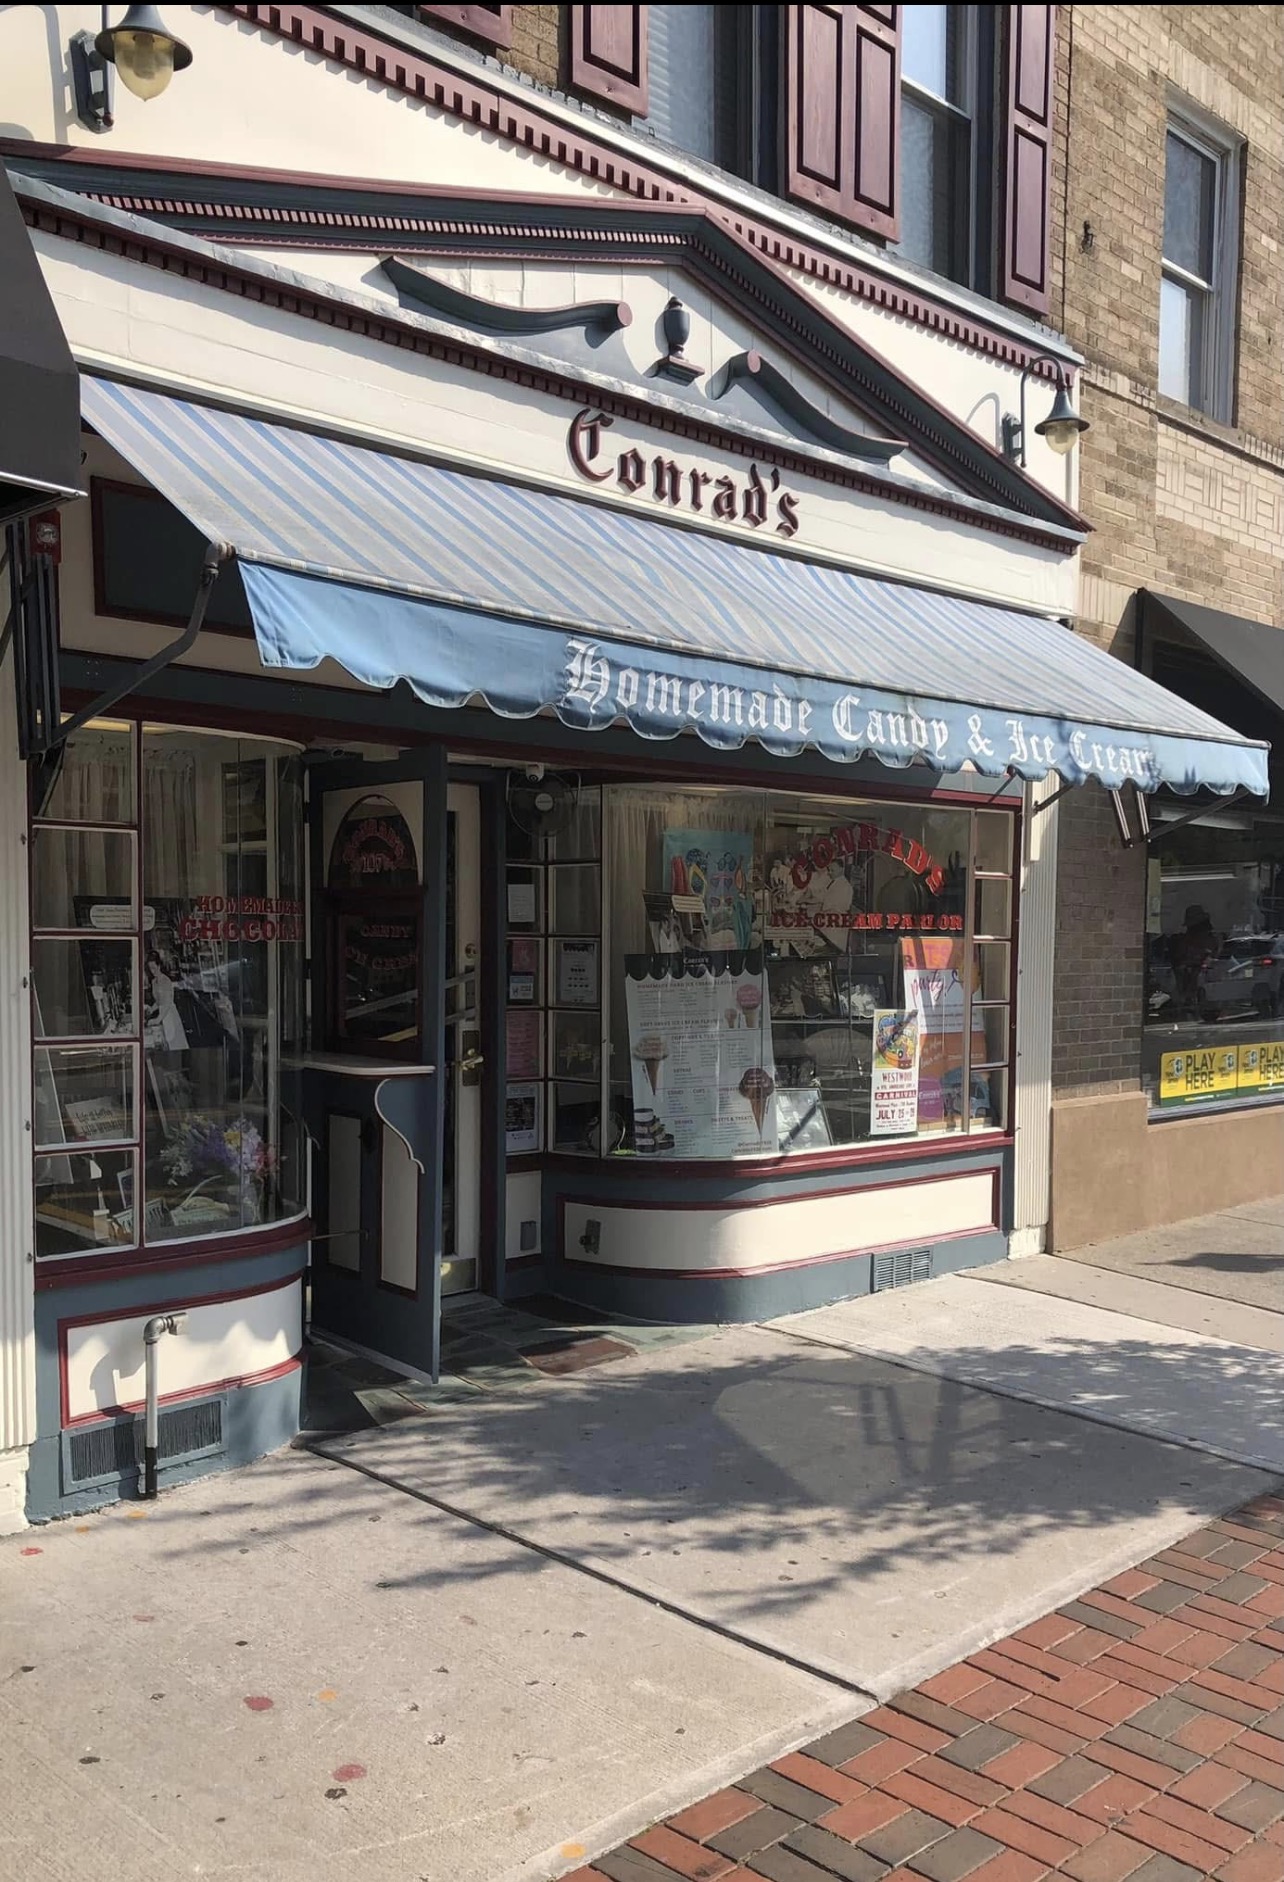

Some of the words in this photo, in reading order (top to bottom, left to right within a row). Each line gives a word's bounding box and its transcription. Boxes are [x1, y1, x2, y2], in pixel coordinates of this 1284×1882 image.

[567, 408, 800, 537] Conrad's
[563, 638, 813, 736] Homemade
[832, 694, 949, 760] Candy
[967, 713, 994, 757] &
[1005, 719, 1058, 764] Ice
[769, 911, 811, 929] ICE
[813, 912, 884, 930] CREAM
[886, 913, 963, 931] PARLOR
[1186, 1052, 1216, 1072] PLAY
[1186, 1071, 1215, 1091] HERE
[876, 1091, 916, 1100] CARNIVAL
[875, 1109, 896, 1120] JULY
